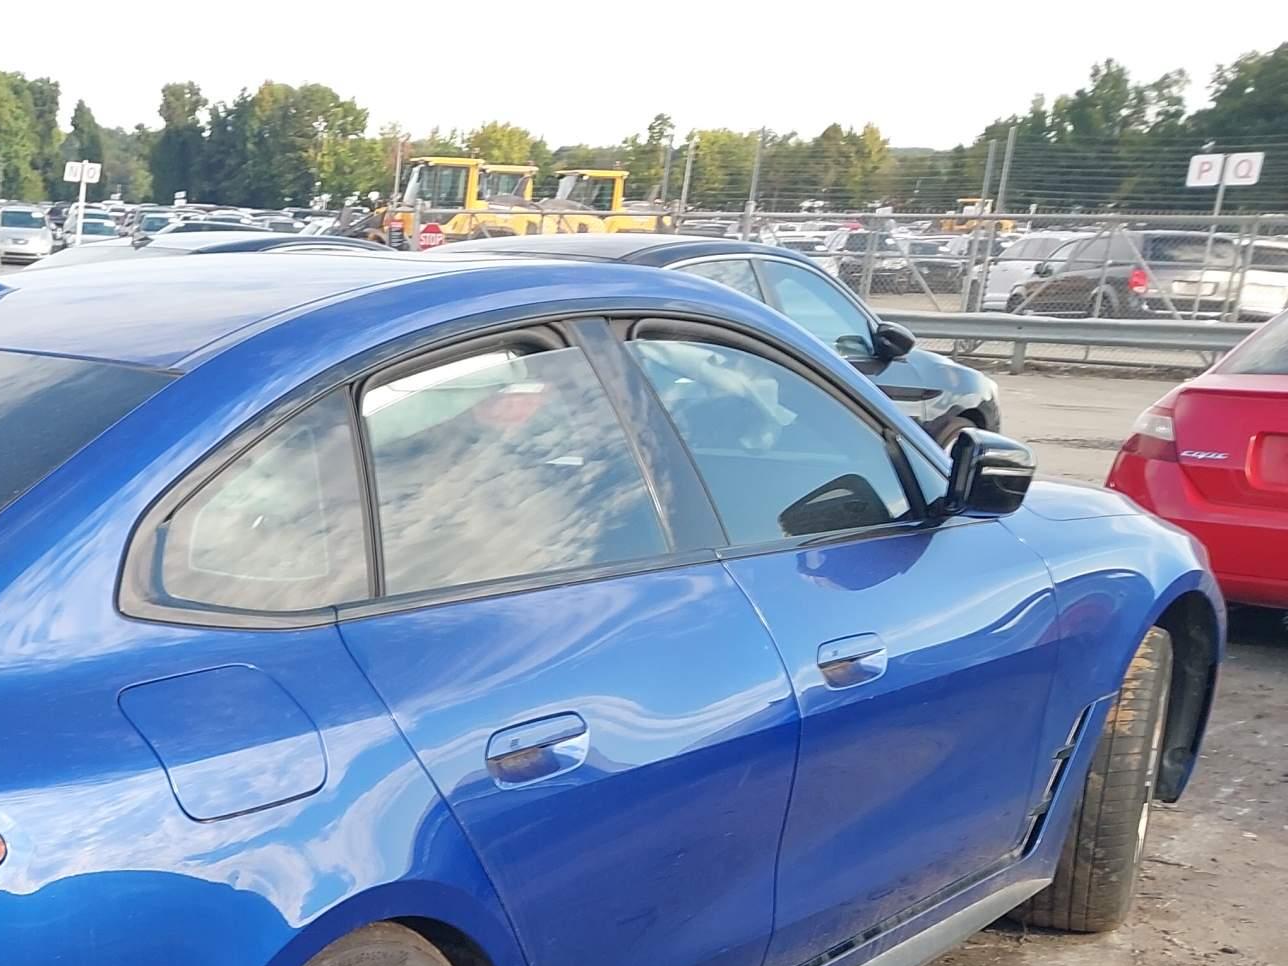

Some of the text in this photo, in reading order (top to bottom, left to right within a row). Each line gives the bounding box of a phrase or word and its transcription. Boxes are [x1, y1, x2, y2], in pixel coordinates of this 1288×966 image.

[1198, 161, 1213, 180] P
[1233, 159, 1254, 179] Q
[419, 233, 444, 245] STOP
